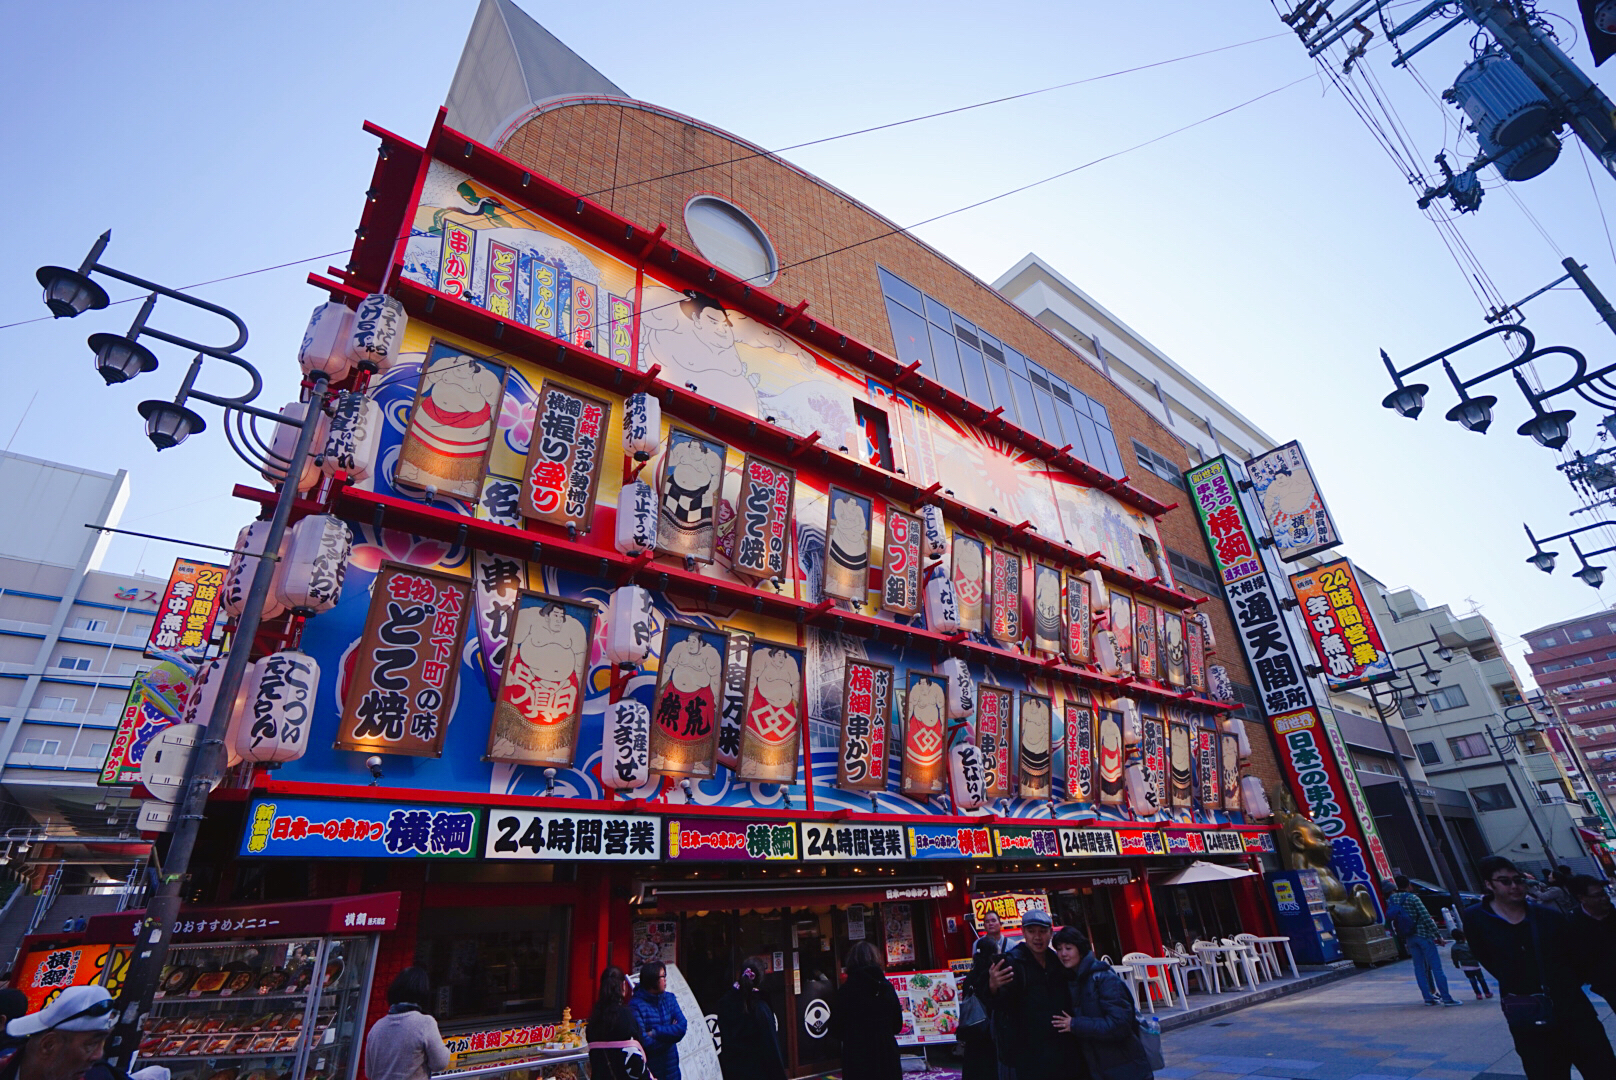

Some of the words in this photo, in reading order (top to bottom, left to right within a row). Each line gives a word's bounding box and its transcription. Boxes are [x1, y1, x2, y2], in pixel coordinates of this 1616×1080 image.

[444, 228, 471, 300] 串かつ
[548, 390, 583, 420] 横綱
[530, 411, 577, 515] 握り盛り
[564, 404, 604, 519] 新鮮ネタが勢揃い
[747, 461, 775, 488] 名物
[1191, 462, 1224, 485] 新世界
[1196, 482, 1218, 512] 串かつ
[1211, 475, 1234, 507] 日本一の
[738, 483, 777, 571] どて焼
[767, 470, 790, 572] 大阪下町の味
[1207, 504, 1254, 566] 横綱
[1291, 514, 1310, 540] 横綱
[885, 511, 911, 609] もつ鍋
[1223, 558, 1261, 583] 通天閣店
[181, 569, 224, 649] 24時間営業
[388, 573, 437, 606] 名物
[1228, 576, 1268, 599] 大相撲
[155, 580, 195, 649] 年中無休
[1305, 595, 1357, 678] 年中無休
[1320, 568, 1381, 668] 24時間営業
[410, 585, 464, 742] 大阪下町の味
[1235, 590, 1300, 694] 通天閣
[352, 601, 437, 742] どて焼
[282, 659, 313, 745] ごっつい
[1265, 686, 1309, 713] 場所
[1274, 713, 1316, 732] 新世界
[103, 704, 138, 781] 日本一の串かつ
[613, 704, 639, 782] おまっせ
[632, 703, 649, 767] お土産も
[845, 664, 874, 783] 横綱串かつ
[869, 669, 891, 779] ボリューム横綱級
[1286, 732, 1346, 836] 日本一の串かつ
[270, 815, 385, 842] 日本一の串かつ
[383, 808, 476, 855] 横綱
[493, 815, 656, 856] 24時間営業
[680, 830, 747, 850] 日本一の串かつ
[745, 823, 796, 859] 横綱
[806, 827, 904, 857] 24時間営業
[915, 834, 959, 850] 日本一の串かつ
[957, 828, 992, 855] 横綱
[1032, 829, 1058, 855] 横綱
[1062, 831, 1116, 853] 24時間営業
[1206, 832, 1242, 851] 24時間営業
[345, 911, 368, 927] 横綱
[1277, 902, 1301, 912] BOSS
[39, 950, 74, 988] 横綱
